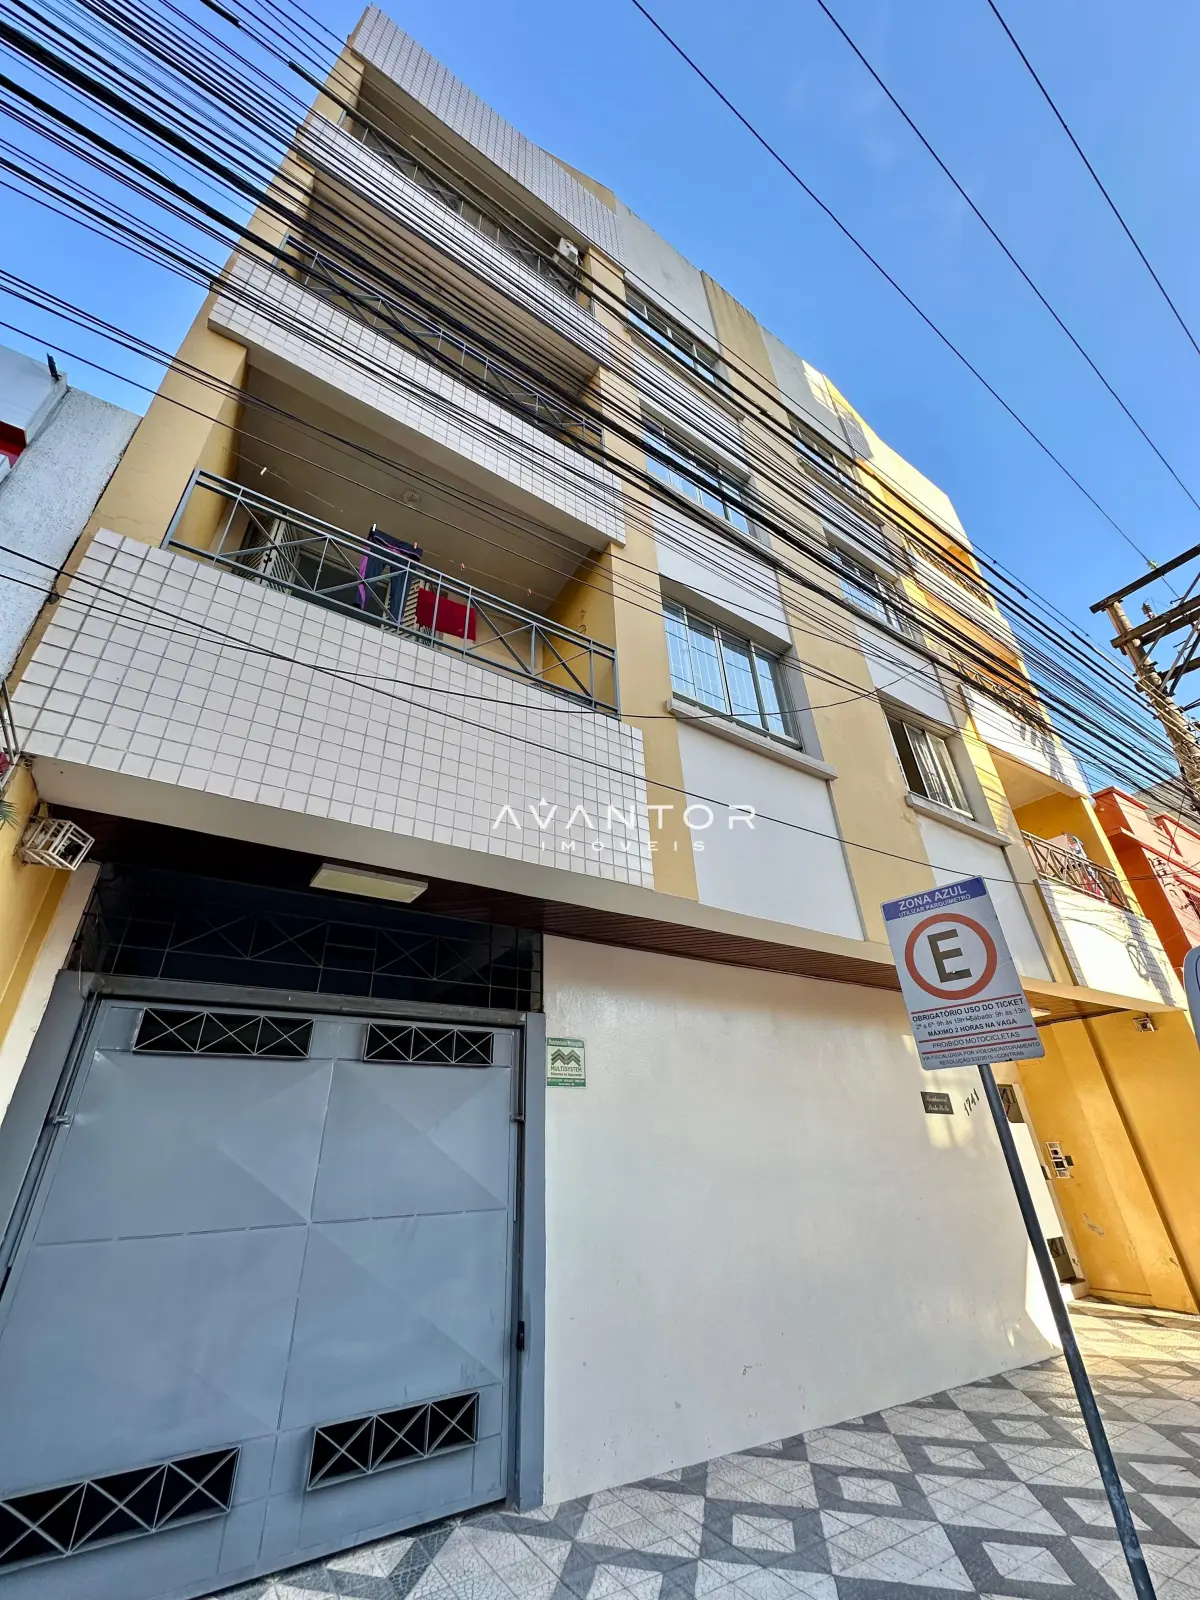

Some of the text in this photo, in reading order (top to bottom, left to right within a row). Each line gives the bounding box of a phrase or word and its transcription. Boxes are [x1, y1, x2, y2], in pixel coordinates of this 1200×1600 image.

[898, 885, 967, 911] ZONA AZUL
[898, 906, 925, 918] UTILIZAR
[926, 928, 973, 984] E
[912, 998, 1025, 1022] OBRIGATÓRIO USO DO TICKET
[1013, 1007, 1027, 1015] 13h
[927, 1026, 954, 1037] MÁXIMO
[959, 1023, 984, 1033] HORAS
[996, 1018, 1018, 1027] VAGA
[932, 1031, 1021, 1049] PROIBIDO MOTOCICLETAS
[997, 1050, 1025, 1060] CONTRAN
[963, 1088, 980, 1116] 1741
